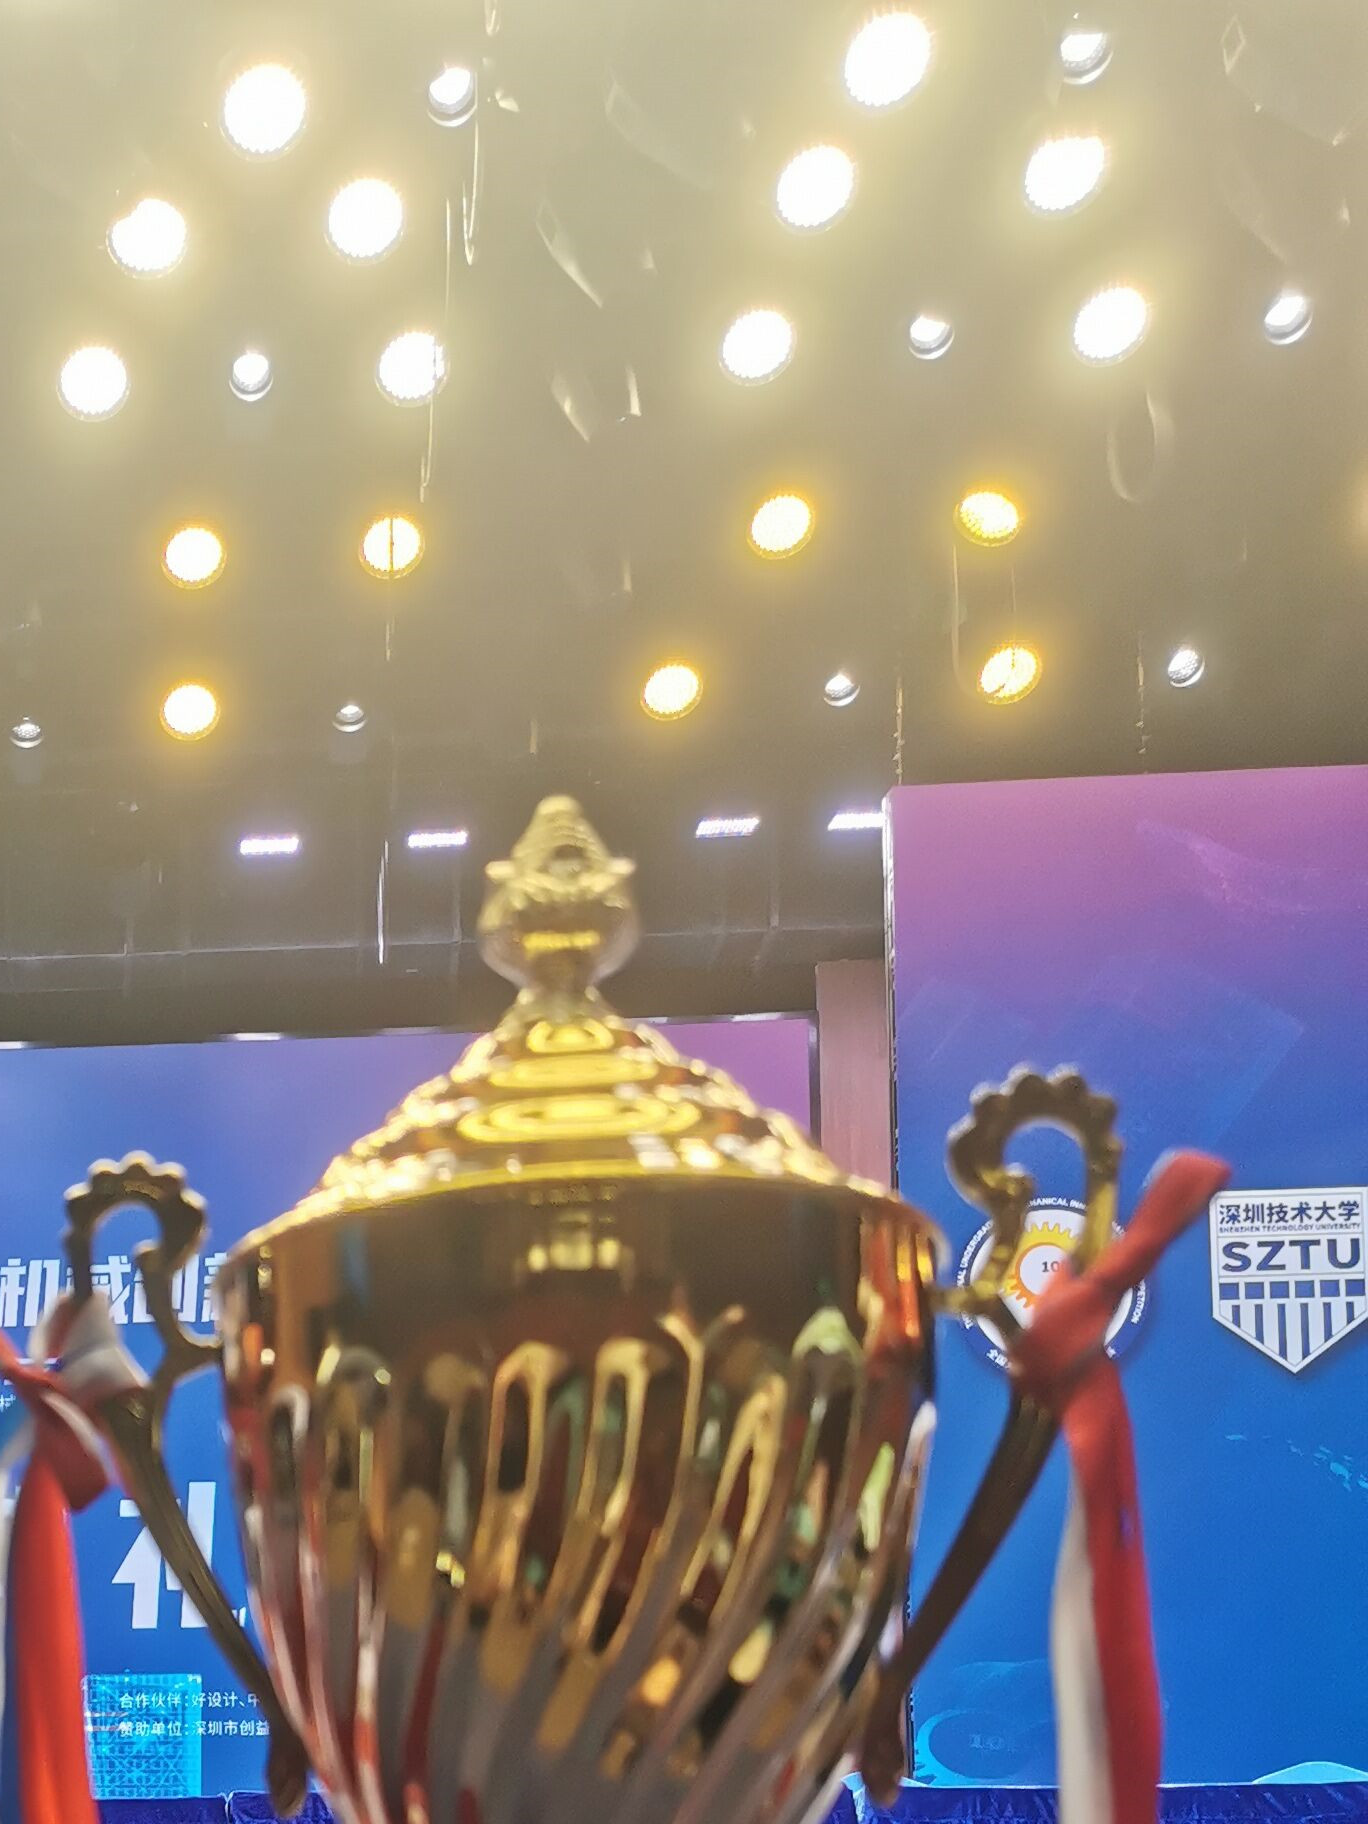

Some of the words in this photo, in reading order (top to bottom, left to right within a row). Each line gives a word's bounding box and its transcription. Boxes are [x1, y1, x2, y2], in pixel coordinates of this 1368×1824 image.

[1219, 1200, 1360, 1224] 深圳技术大学
[1262, 1223, 1314, 1232] TECHNOLOGY
[1315, 1222, 1361, 1231] UNIVERSITY
[1222, 1237, 1361, 1273] SZTU
